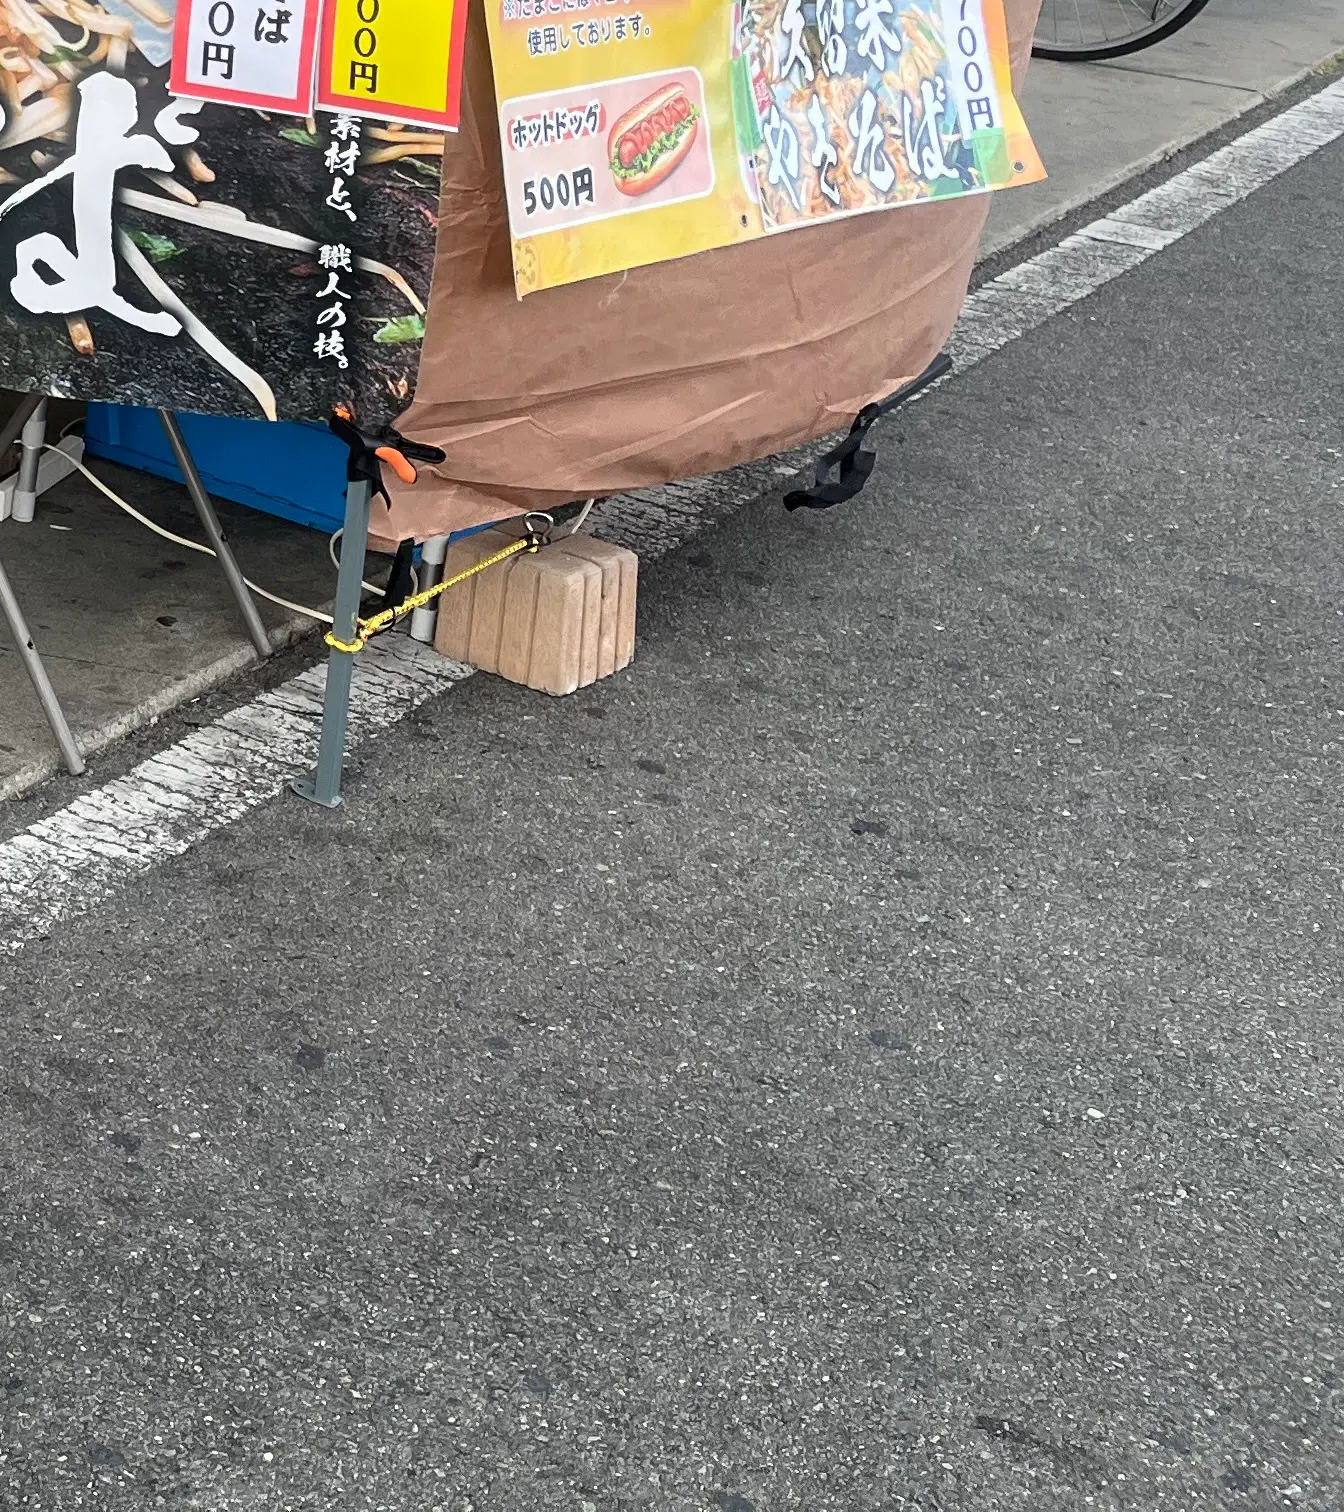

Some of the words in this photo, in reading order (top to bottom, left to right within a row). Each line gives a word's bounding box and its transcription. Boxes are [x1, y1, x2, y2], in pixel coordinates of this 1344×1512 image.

[528, 14, 651, 55] 使用しております。
[513, 104, 599, 148] ホットドッグ
[764, 76, 959, 211] やきそば
[523, 167, 594, 215] 500円
